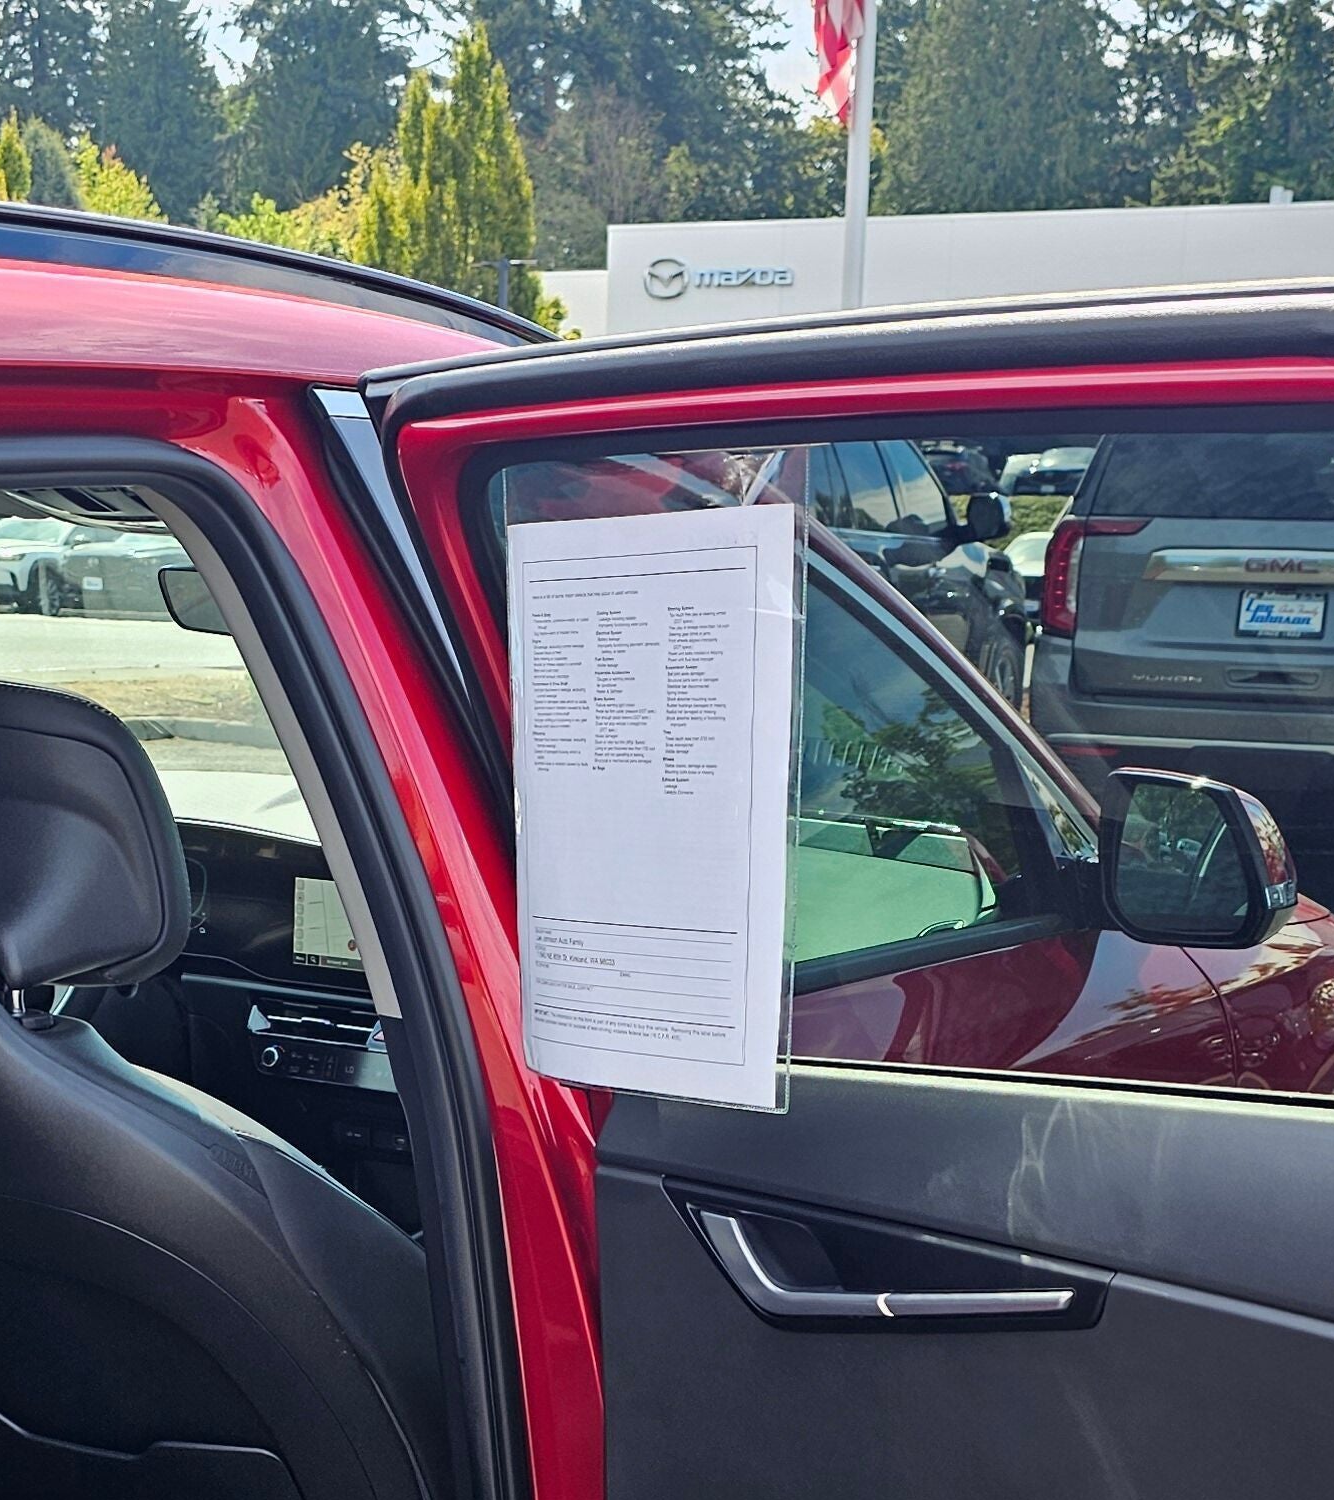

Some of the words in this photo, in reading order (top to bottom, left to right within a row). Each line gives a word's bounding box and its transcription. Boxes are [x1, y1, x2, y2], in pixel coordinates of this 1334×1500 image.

[1245, 557, 1320, 574] GMC
[1245, 610, 1312, 625] Johnson
[1132, 673, 1203, 684] YUKON
